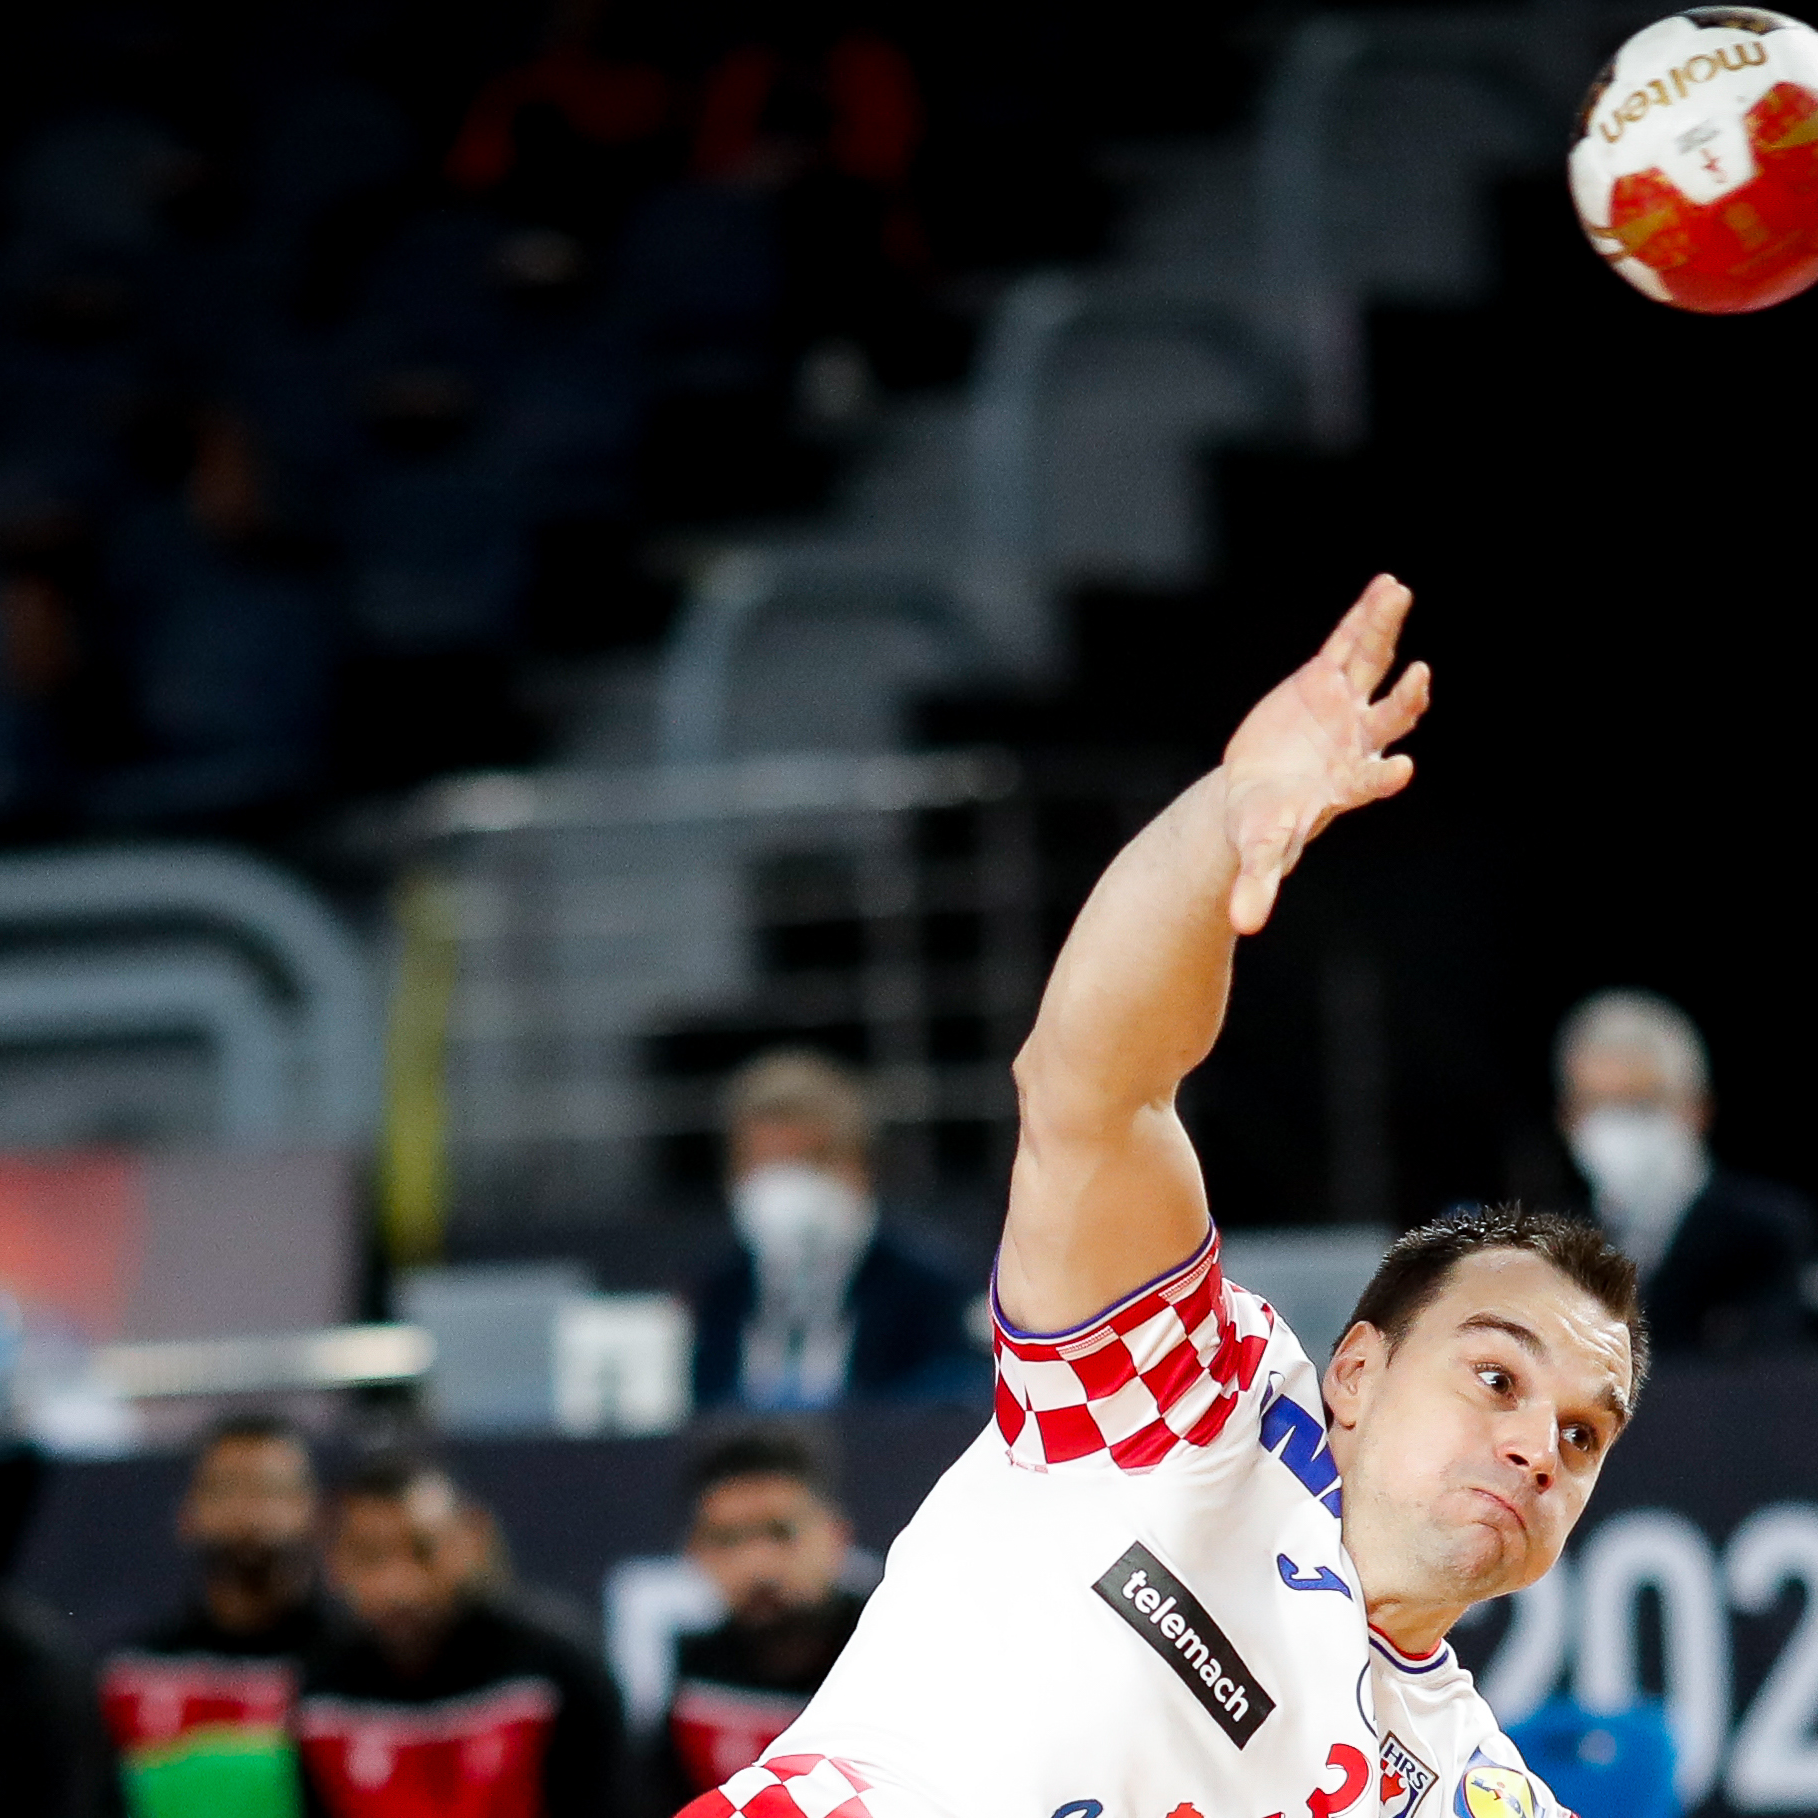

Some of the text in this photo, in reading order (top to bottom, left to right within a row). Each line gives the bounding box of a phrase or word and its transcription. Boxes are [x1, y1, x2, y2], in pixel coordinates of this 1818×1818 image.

[1599, 41, 1769, 143] molten
[1121, 1569, 1250, 1723] telemach
[1384, 1742, 1429, 1790] HRS
